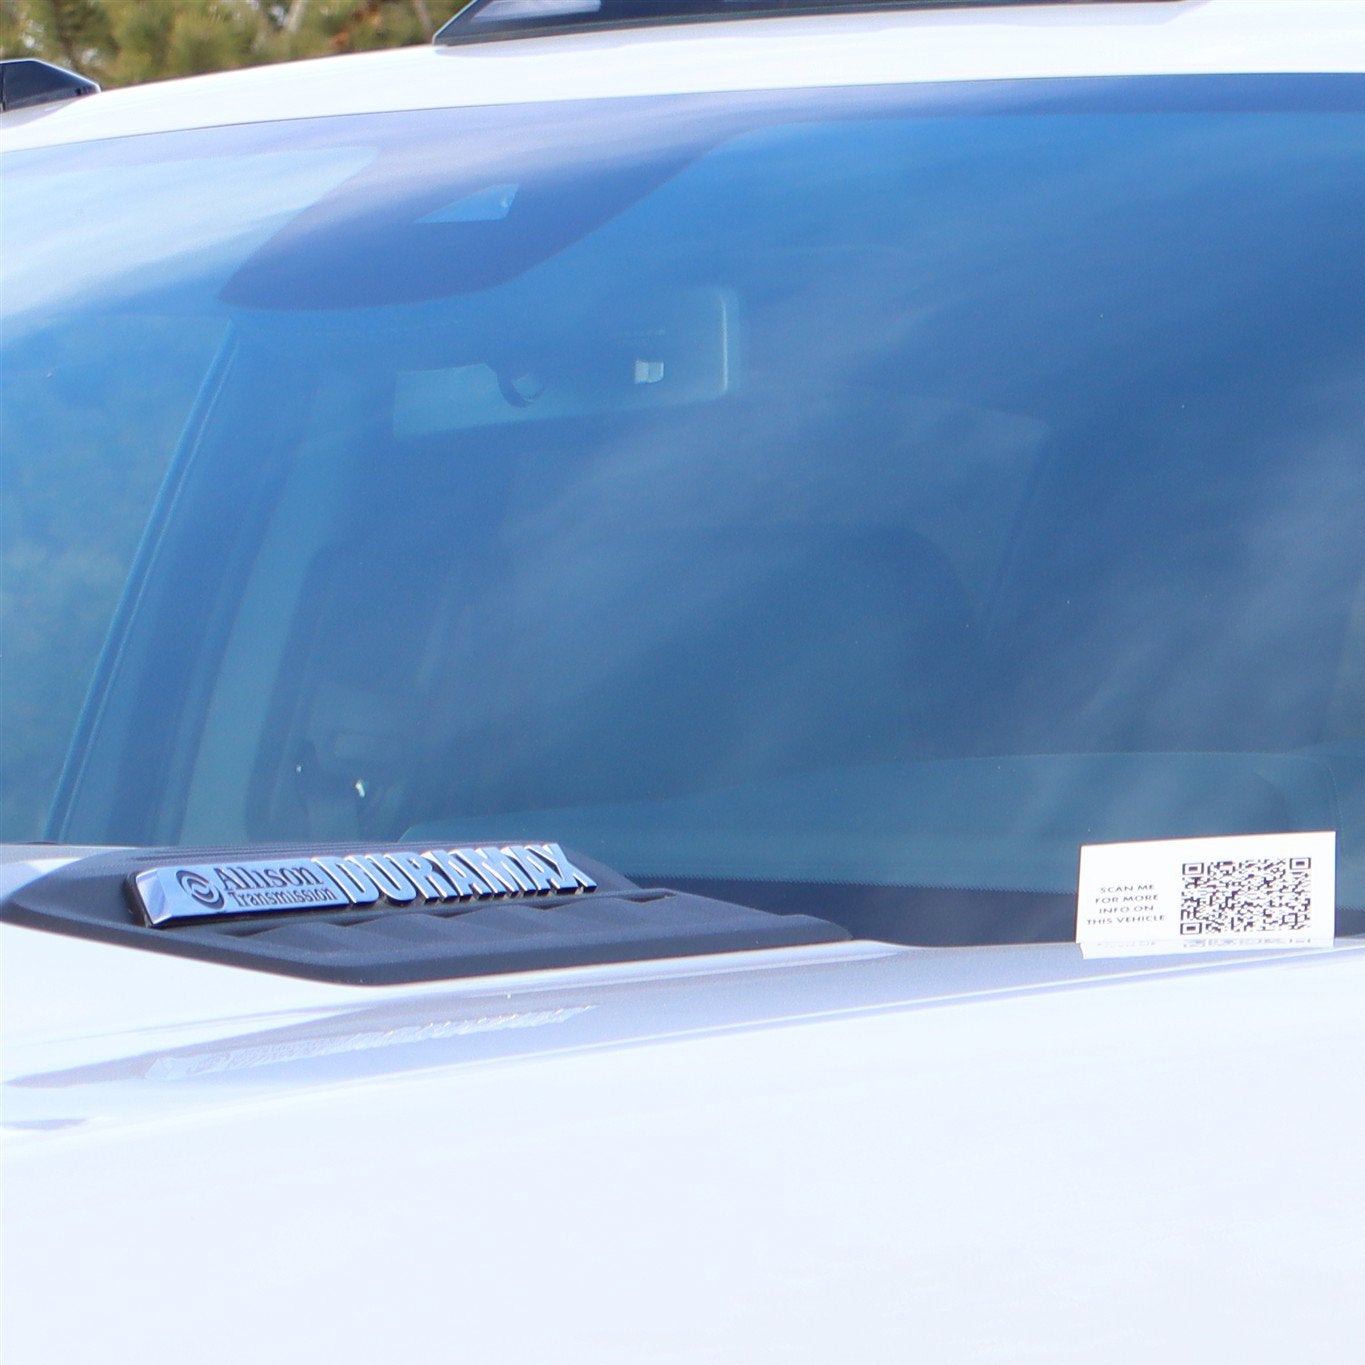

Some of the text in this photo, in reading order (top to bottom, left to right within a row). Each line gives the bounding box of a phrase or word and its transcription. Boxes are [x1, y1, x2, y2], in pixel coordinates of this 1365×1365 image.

[213, 866, 325, 891] Allison
[311, 843, 597, 905] DURAMAX
[227, 887, 338, 908] Transmission
[1099, 906, 1129, 914] INFO
[1116, 915, 1164, 923] VEHICLE
